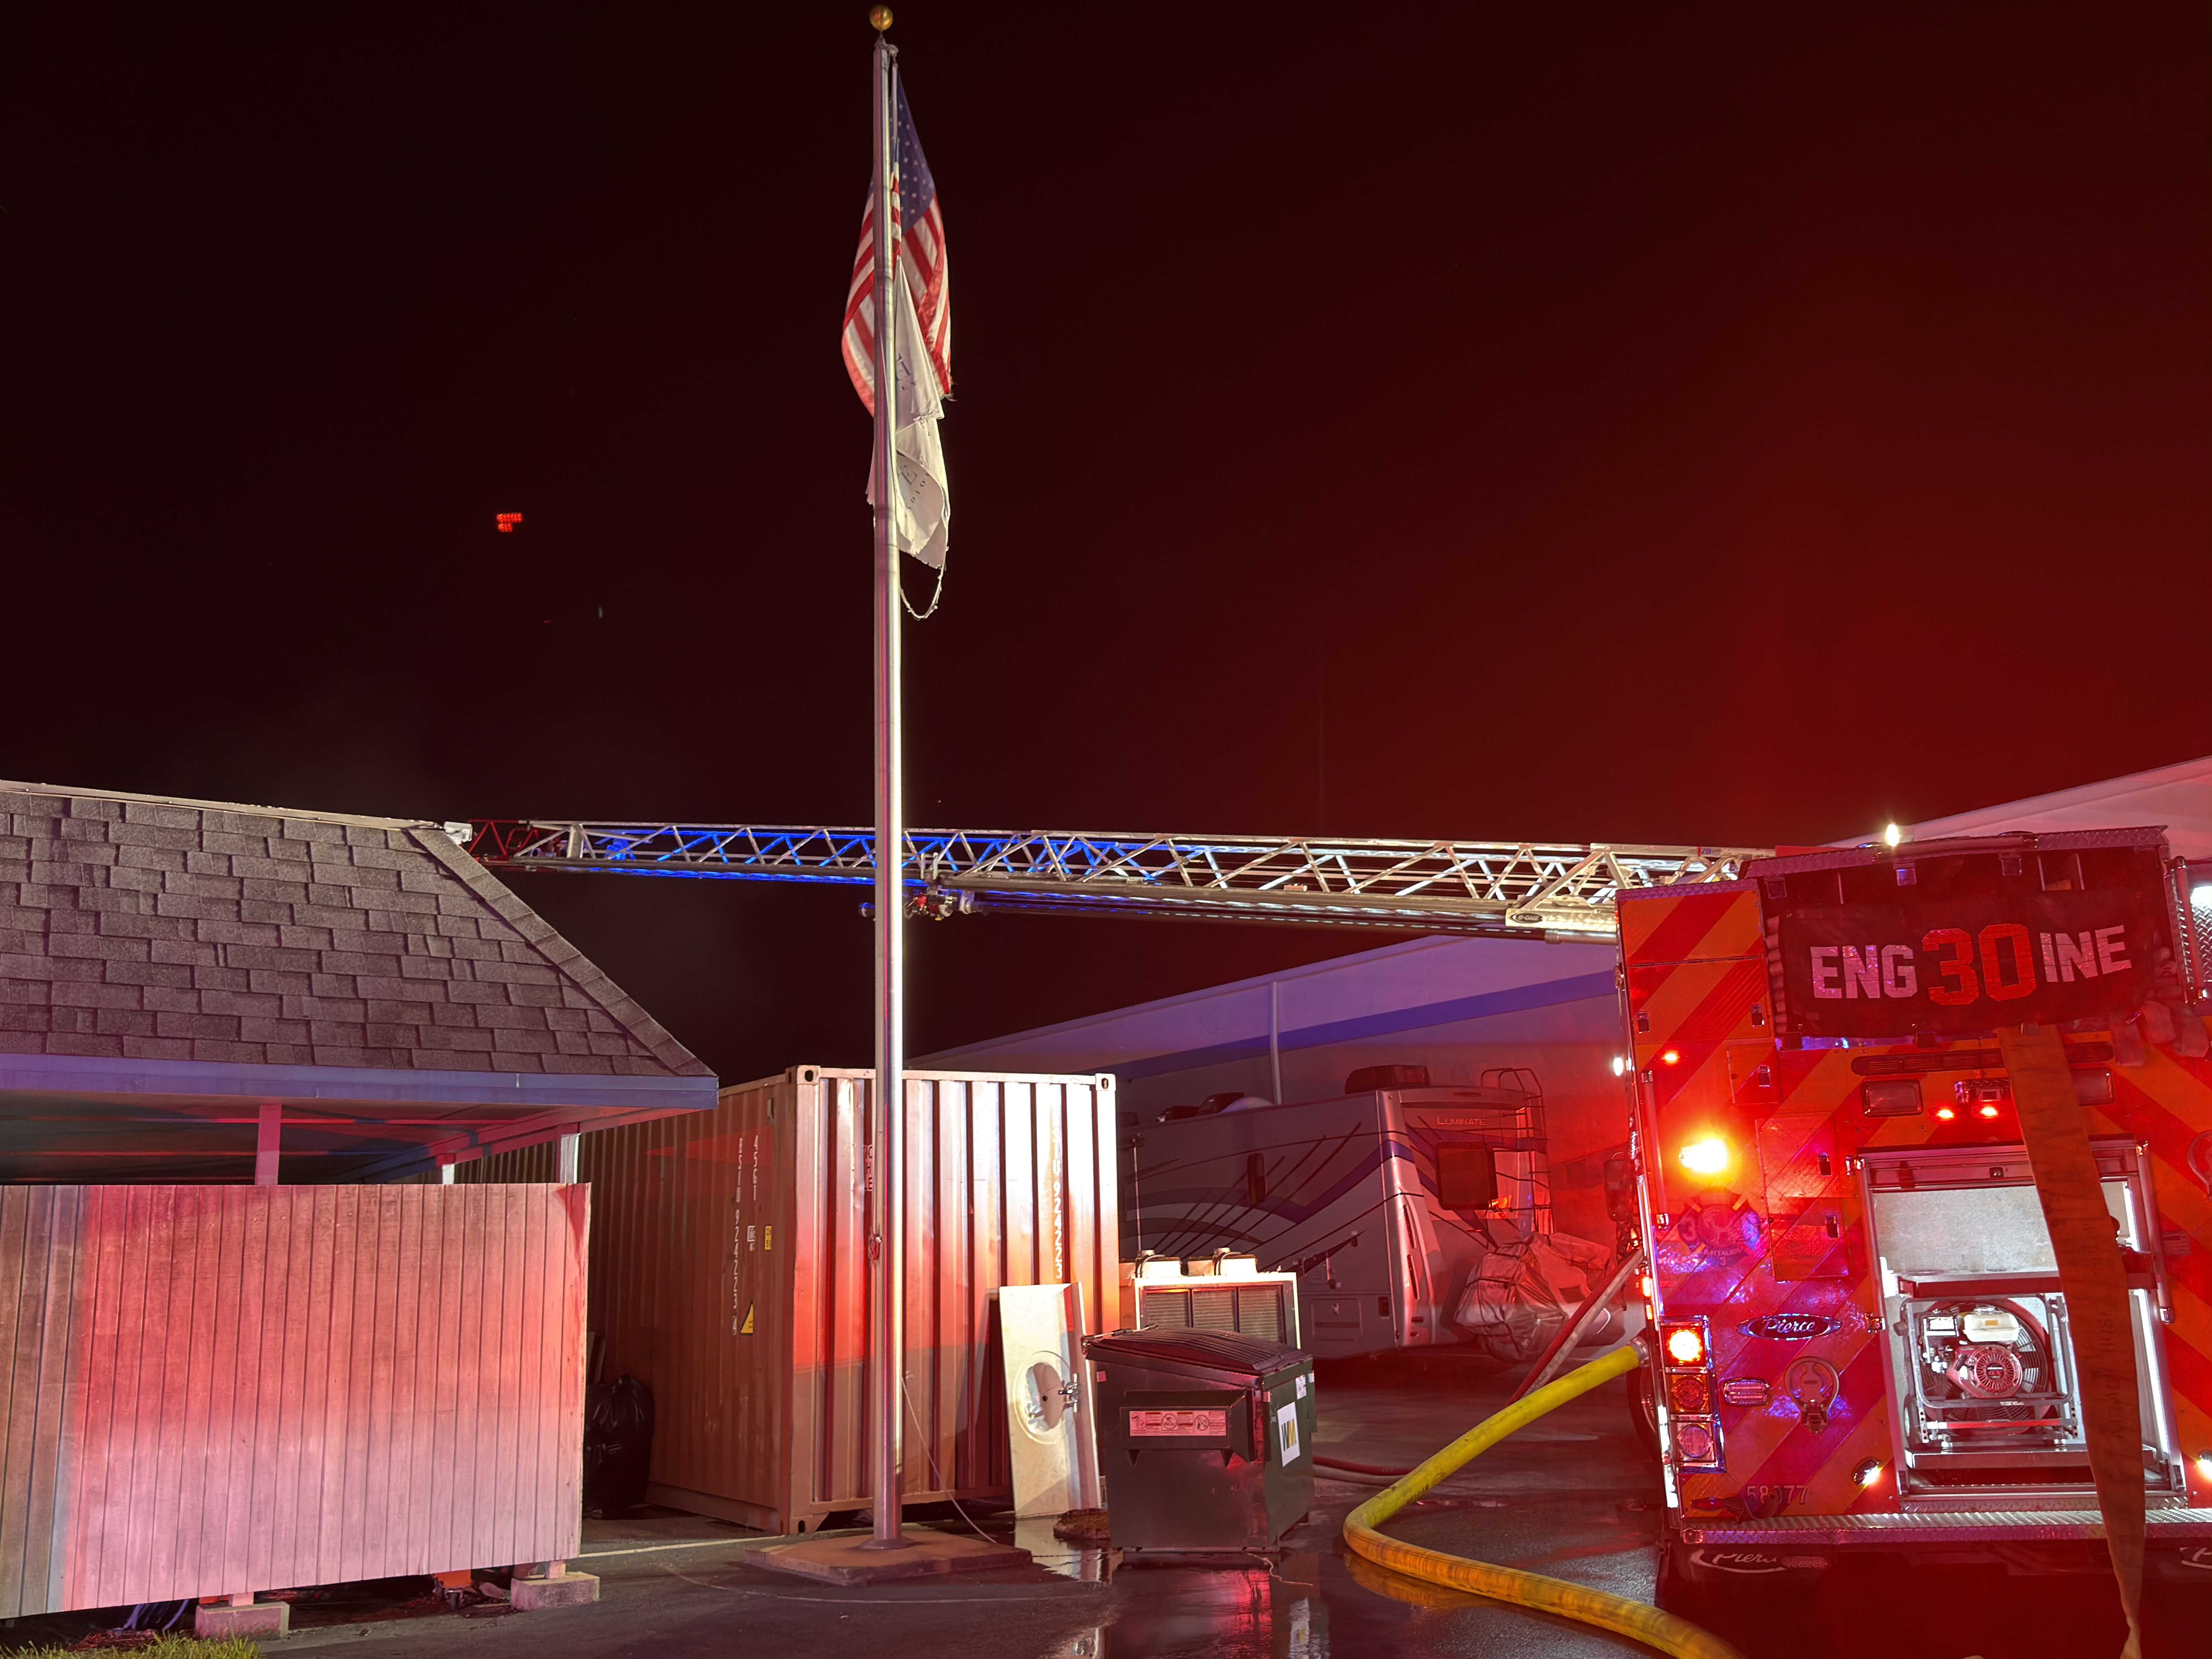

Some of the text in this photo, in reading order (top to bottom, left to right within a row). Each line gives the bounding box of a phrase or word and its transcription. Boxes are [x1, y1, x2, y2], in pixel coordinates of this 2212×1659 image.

[1810, 923, 2132, 1006] ENG 30 INE
[1760, 1318, 1815, 1336] Pierce
[1281, 1418, 1297, 1451] WM
